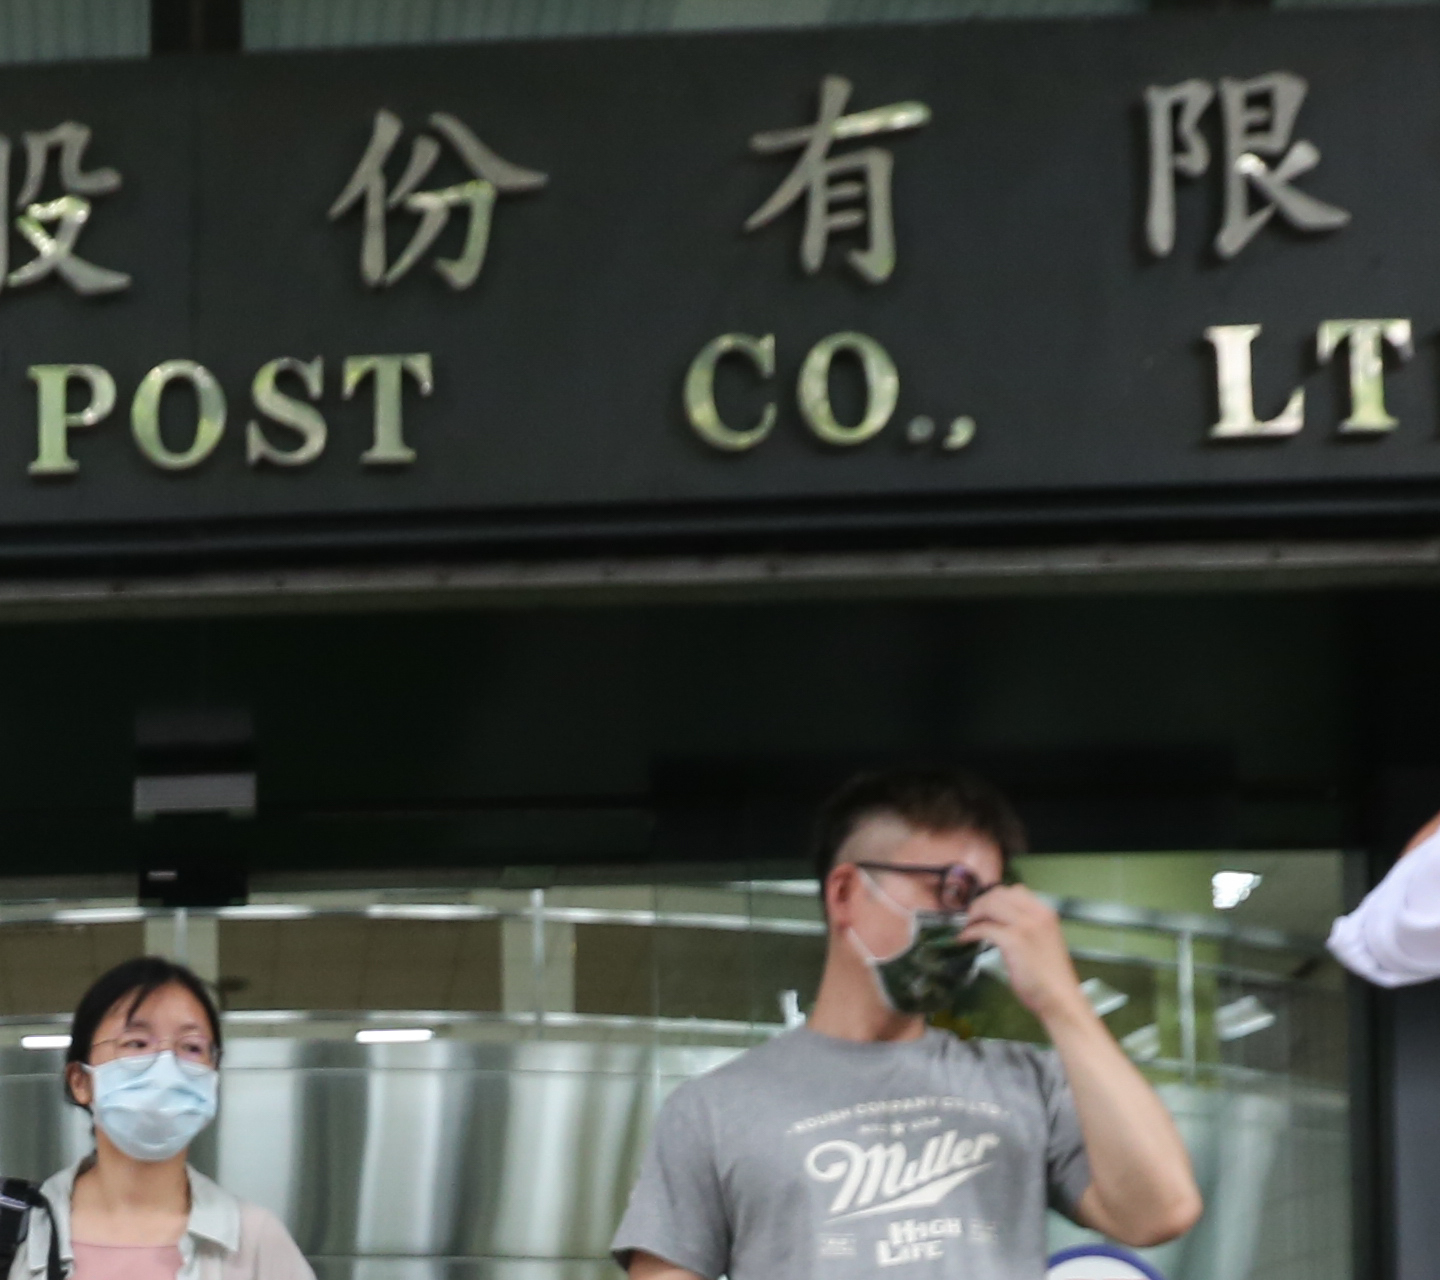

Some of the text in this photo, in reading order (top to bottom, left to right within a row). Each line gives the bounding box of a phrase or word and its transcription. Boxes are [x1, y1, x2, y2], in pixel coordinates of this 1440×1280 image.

[26, 350, 434, 478] POST
[682, 328, 977, 452] CO.,
[804, 1130, 1000, 1213] Miller
